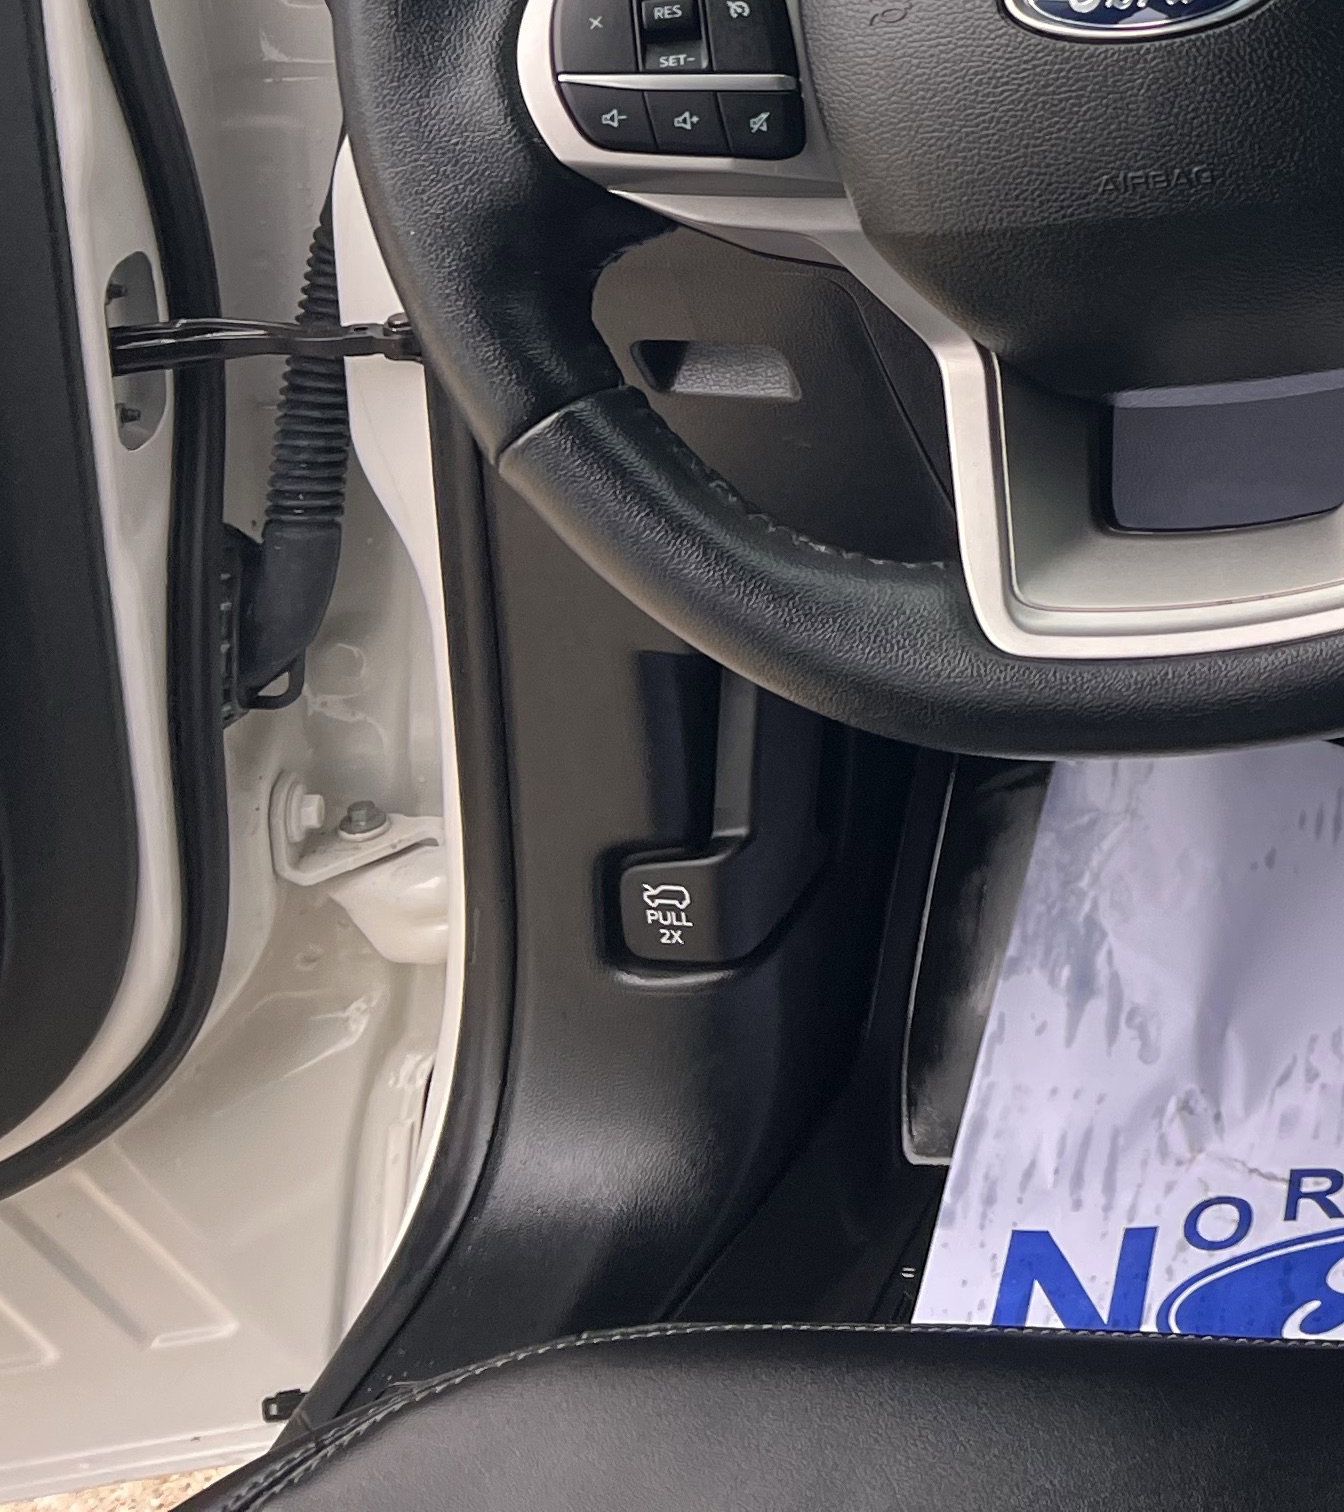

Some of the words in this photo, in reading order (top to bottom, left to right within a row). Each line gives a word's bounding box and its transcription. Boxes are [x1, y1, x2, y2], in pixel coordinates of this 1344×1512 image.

[654, 5, 682, 19] RES
[1099, 165, 1215, 193] AIRBAG
[646, 909, 694, 927] PULL
[659, 928, 685, 945] 2X
